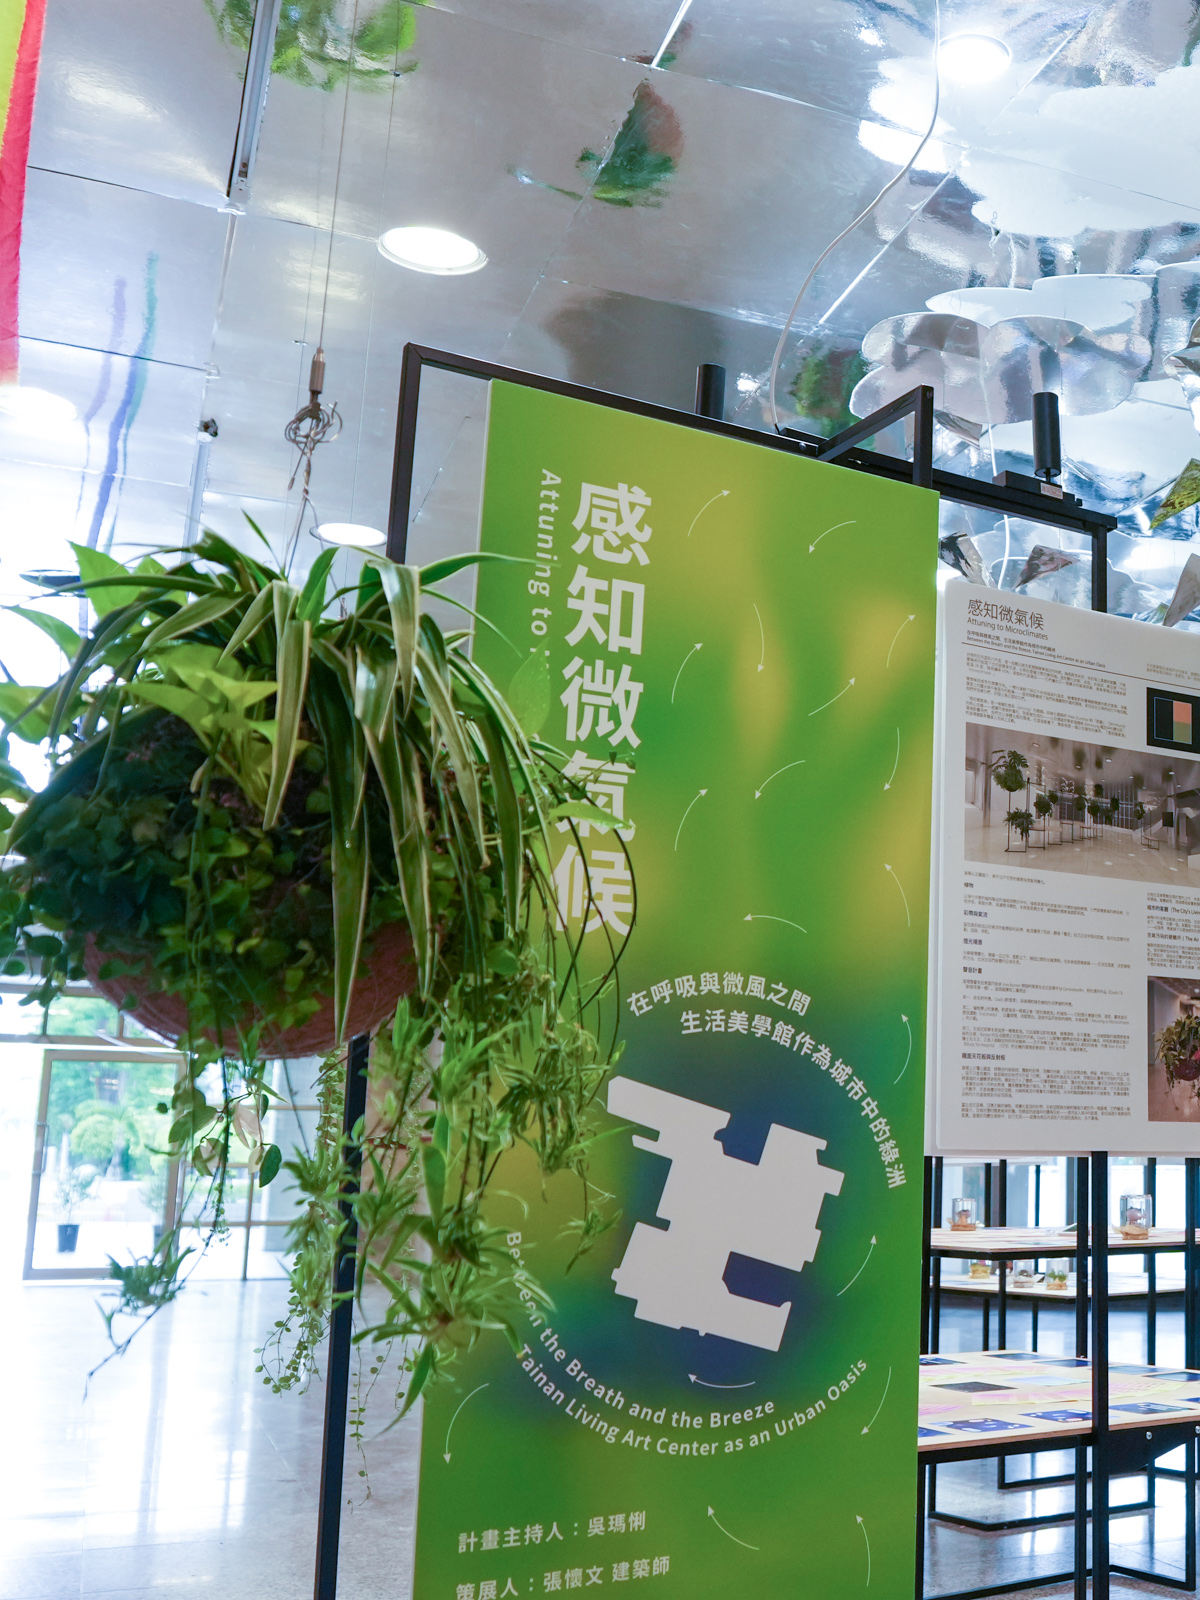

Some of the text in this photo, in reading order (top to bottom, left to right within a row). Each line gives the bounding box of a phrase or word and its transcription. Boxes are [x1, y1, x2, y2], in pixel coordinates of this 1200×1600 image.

[527, 468, 562, 598] Attuning
[530, 607, 552, 636] to
[967, 617, 1049, 640] Attuning to Microclimates
[968, 599, 1044, 631] 感知微氣候
[552, 482, 653, 937] 感知微氣候
[626, 971, 811, 1016] 在呼吸與微風之間
[680, 1008, 907, 1189] 生活美學館作為城市中的綠洲
[521, 1344, 868, 1457] Tainan Living Art Center as an Urban Oasis
[539, 1327, 566, 1362] the
[565, 1358, 626, 1410] Breath
[628, 1402, 666, 1425] and
[671, 1410, 703, 1429] the
[709, 1401, 775, 1429] Breeze
[458, 1510, 646, 1554] 計畫主持人：吳瑪悧
[611, 1555, 670, 1583] 建築師
